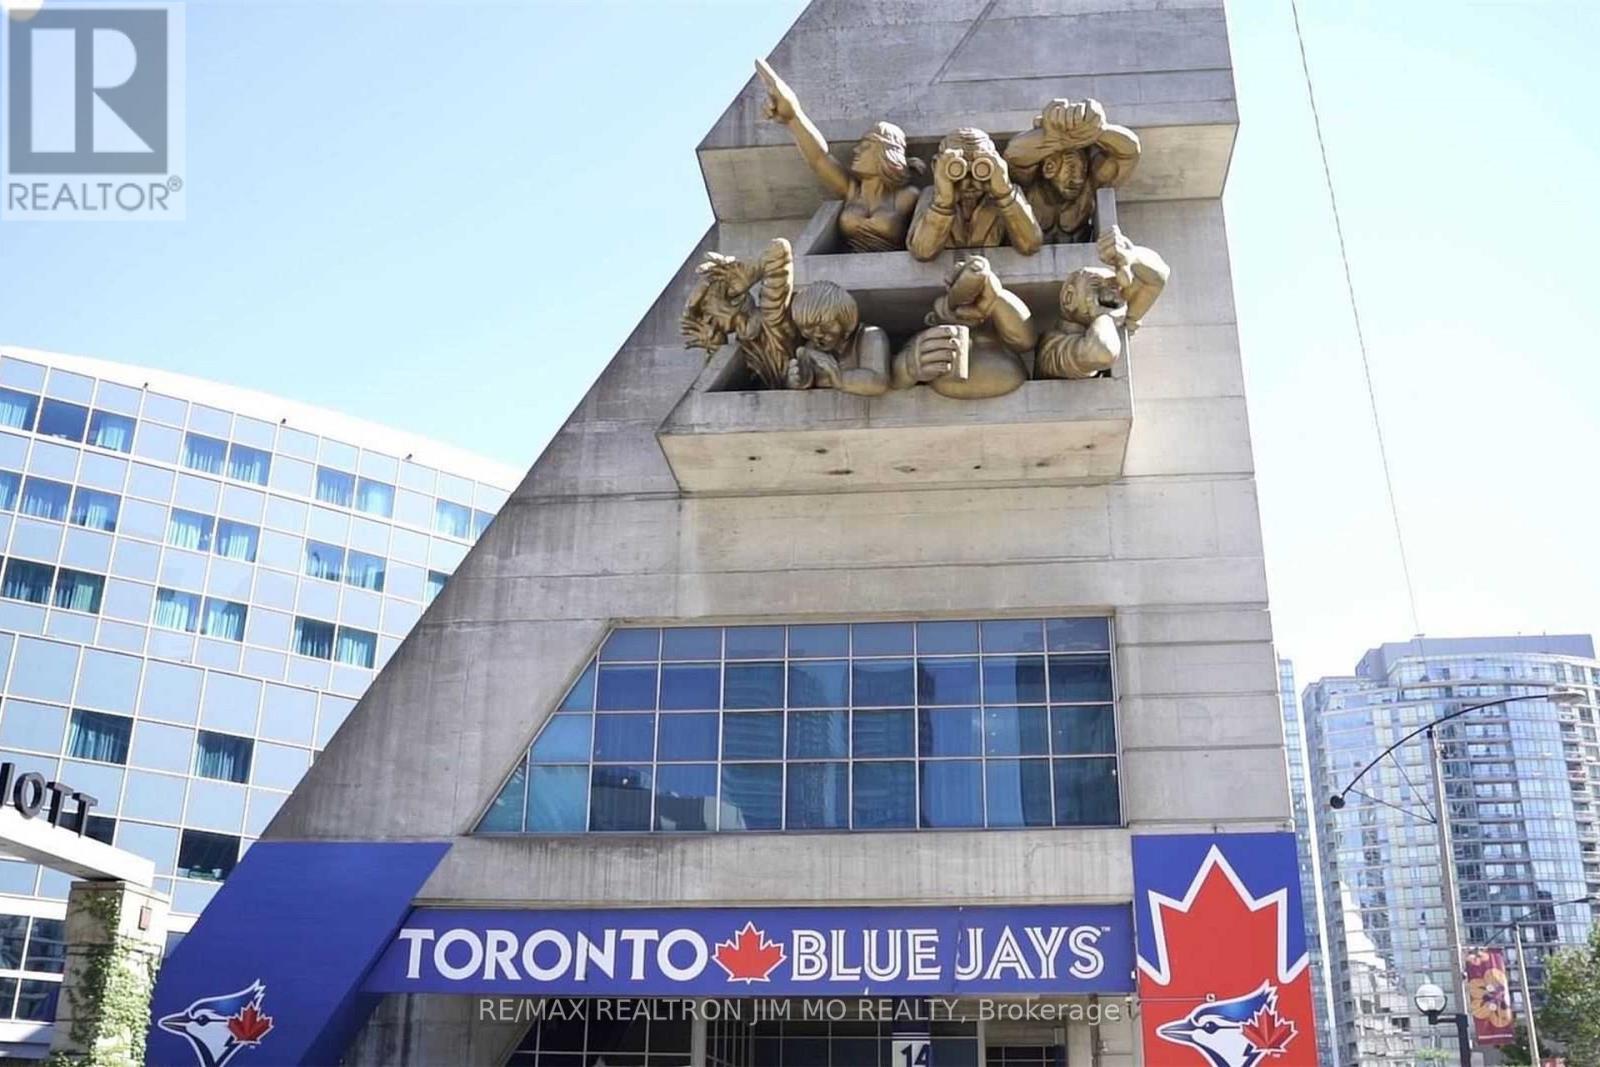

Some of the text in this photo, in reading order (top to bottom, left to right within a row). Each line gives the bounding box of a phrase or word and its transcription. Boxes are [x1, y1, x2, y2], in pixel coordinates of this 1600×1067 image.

[399, 928, 708, 982] TORONTO
[791, 928, 942, 982] BLUE
[901, 1043, 931, 1067] 14
